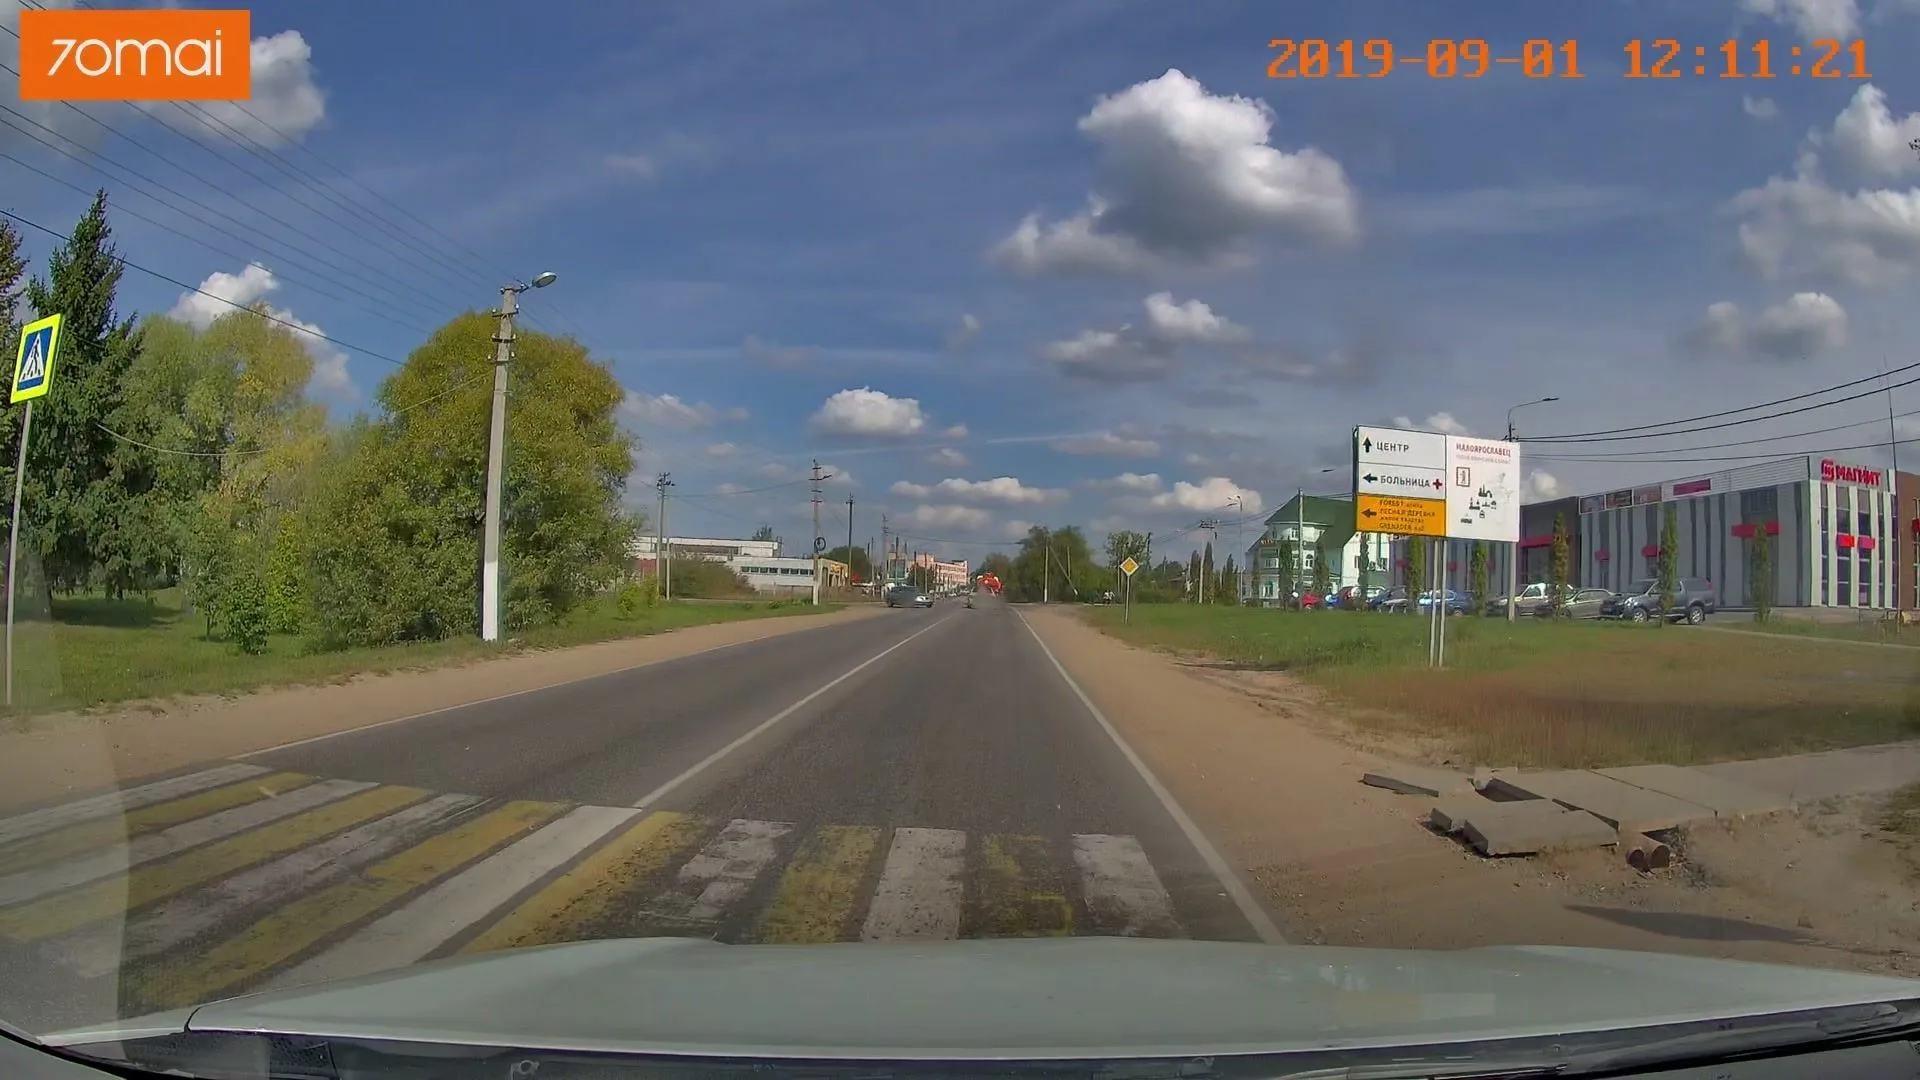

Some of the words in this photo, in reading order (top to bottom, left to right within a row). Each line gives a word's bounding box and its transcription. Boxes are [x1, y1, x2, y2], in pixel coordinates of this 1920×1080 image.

[1376, 441, 1409, 453] ЦЕНТР
[1456, 443, 1511, 458] МАЛОЯРОСЛАВЕЦ
[1380, 475, 1431, 488] БОЛЬНИЦА
